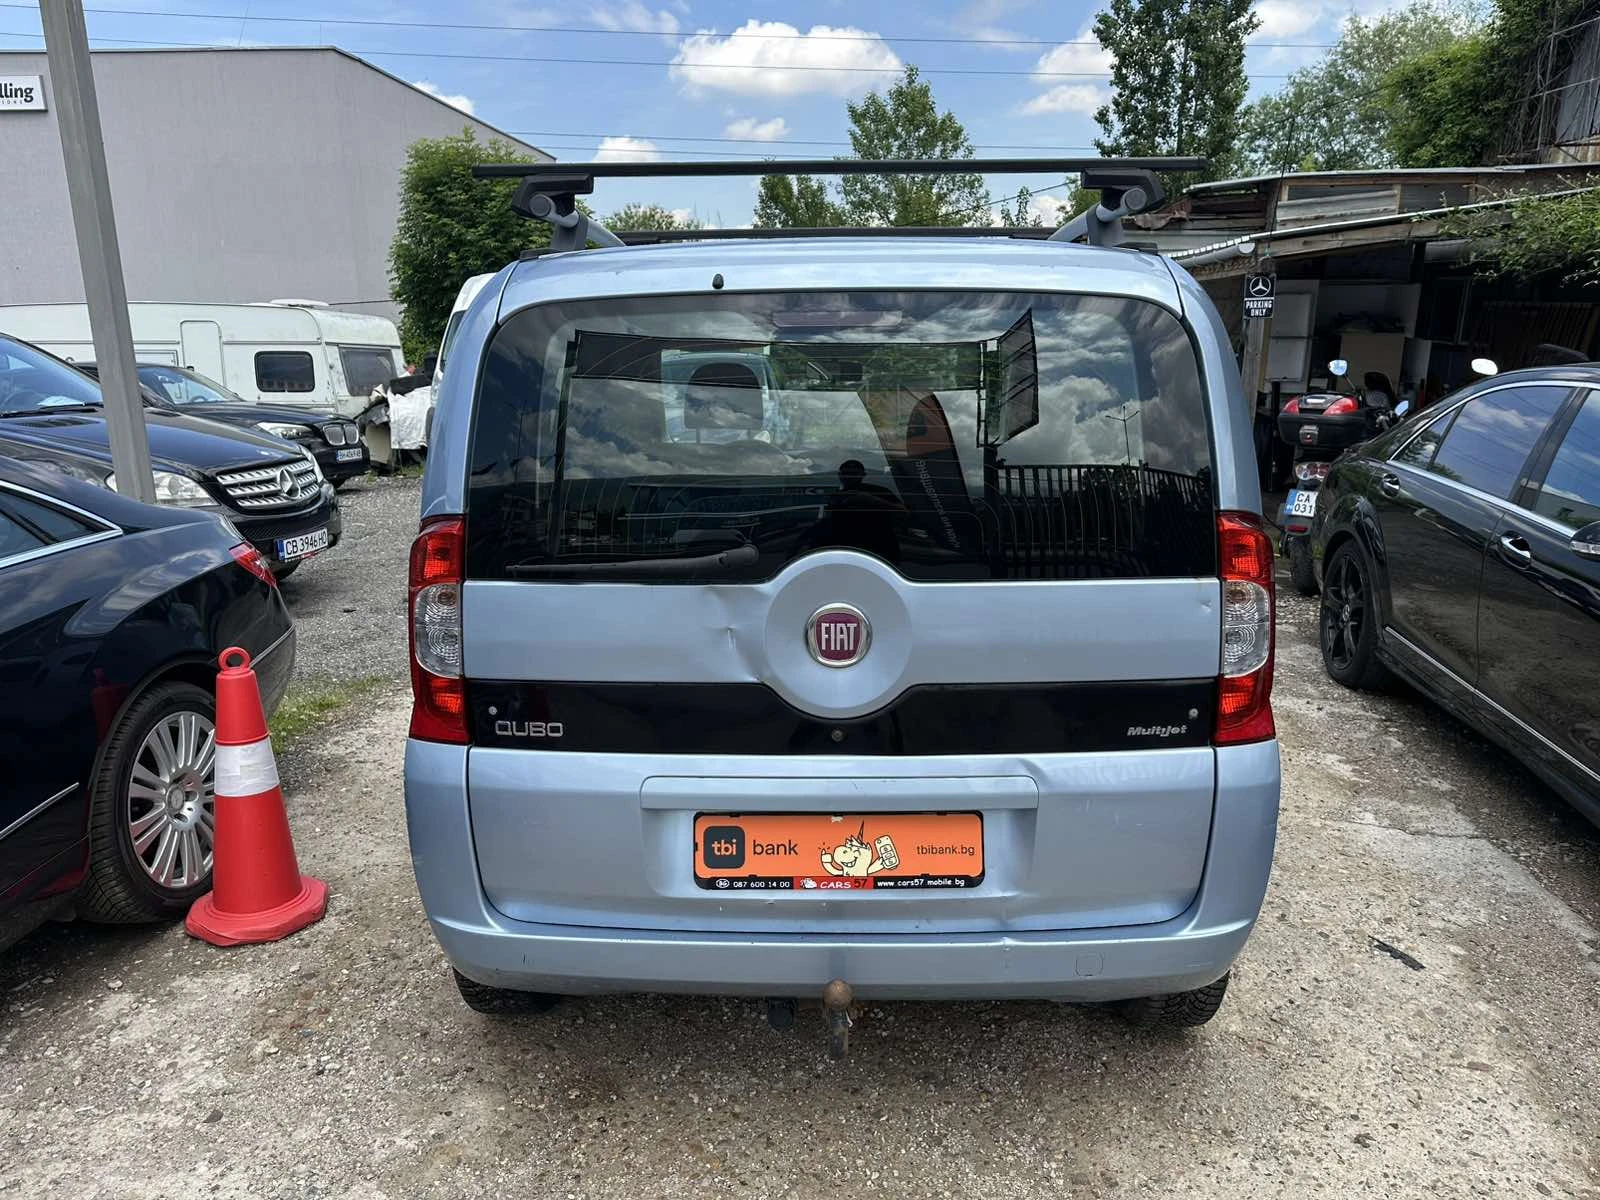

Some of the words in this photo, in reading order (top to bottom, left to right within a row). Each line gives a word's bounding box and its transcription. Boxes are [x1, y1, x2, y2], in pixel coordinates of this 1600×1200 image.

[1245, 300, 1272, 309] PARKING
[1250, 308, 1267, 317] ONLY
[1296, 492, 1311, 504] CA
[1294, 503, 1313, 514] 031
[285, 540, 299, 555] CB
[299, 535, 319, 552] 3946
[821, 622, 858, 651] FIAT
[495, 720, 564, 737] QUBO
[711, 838, 737, 856] tbi
[752, 839, 799, 856] bank
[916, 844, 976, 856] tbibank.bg
[819, 881, 851, 889] CARS
[854, 878, 868, 889] 57
